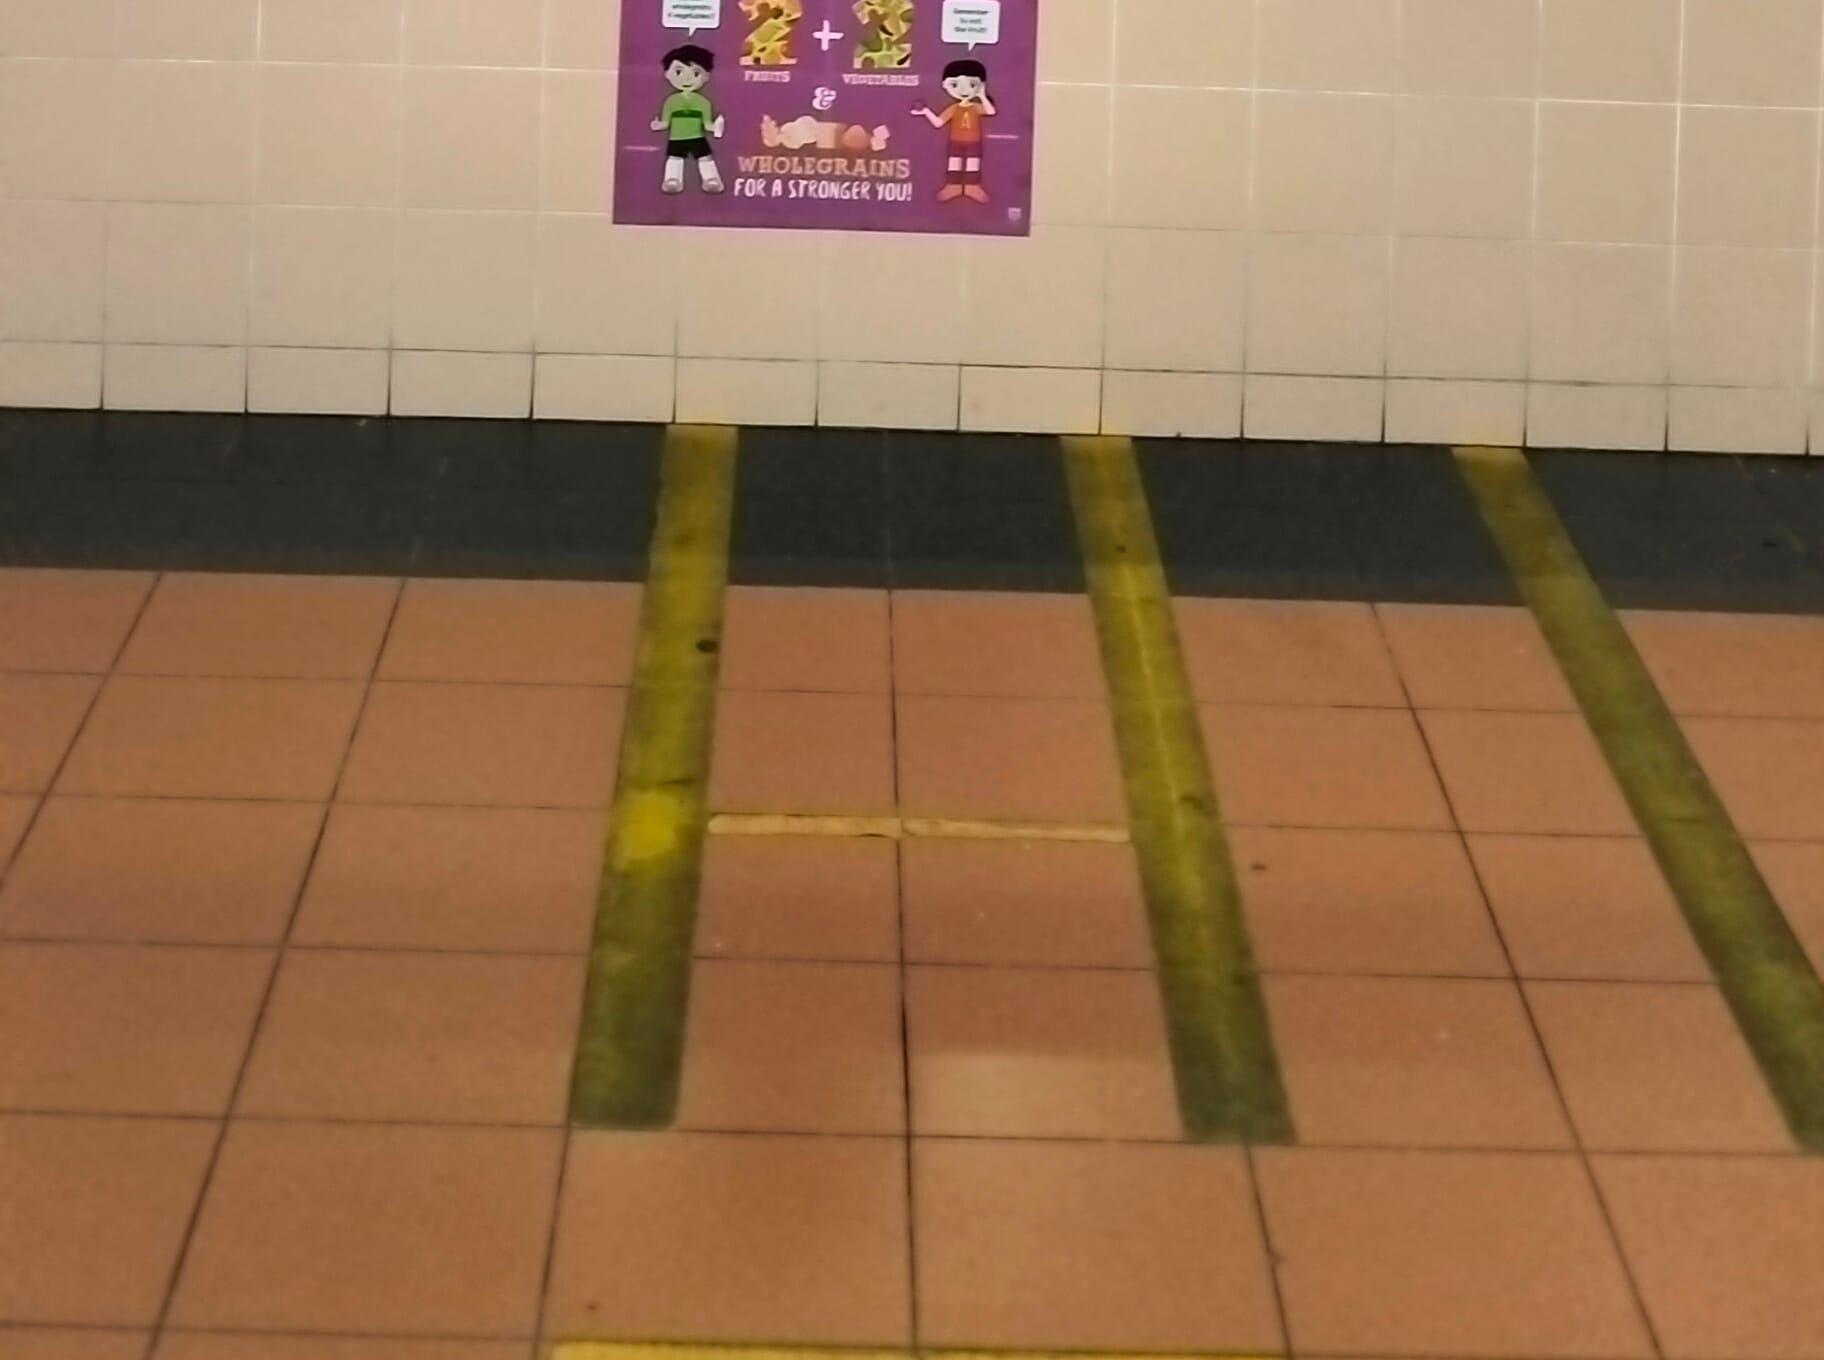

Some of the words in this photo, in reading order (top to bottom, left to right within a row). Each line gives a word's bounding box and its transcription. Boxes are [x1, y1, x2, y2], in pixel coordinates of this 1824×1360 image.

[812, 87, 836, 110] &
[737, 156, 910, 178] WHOLEGRAINS
[734, 178, 766, 197] FOR
[772, 179, 782, 197] A
[788, 179, 870, 200] STRONGER
[876, 182, 912, 201] YOU!
